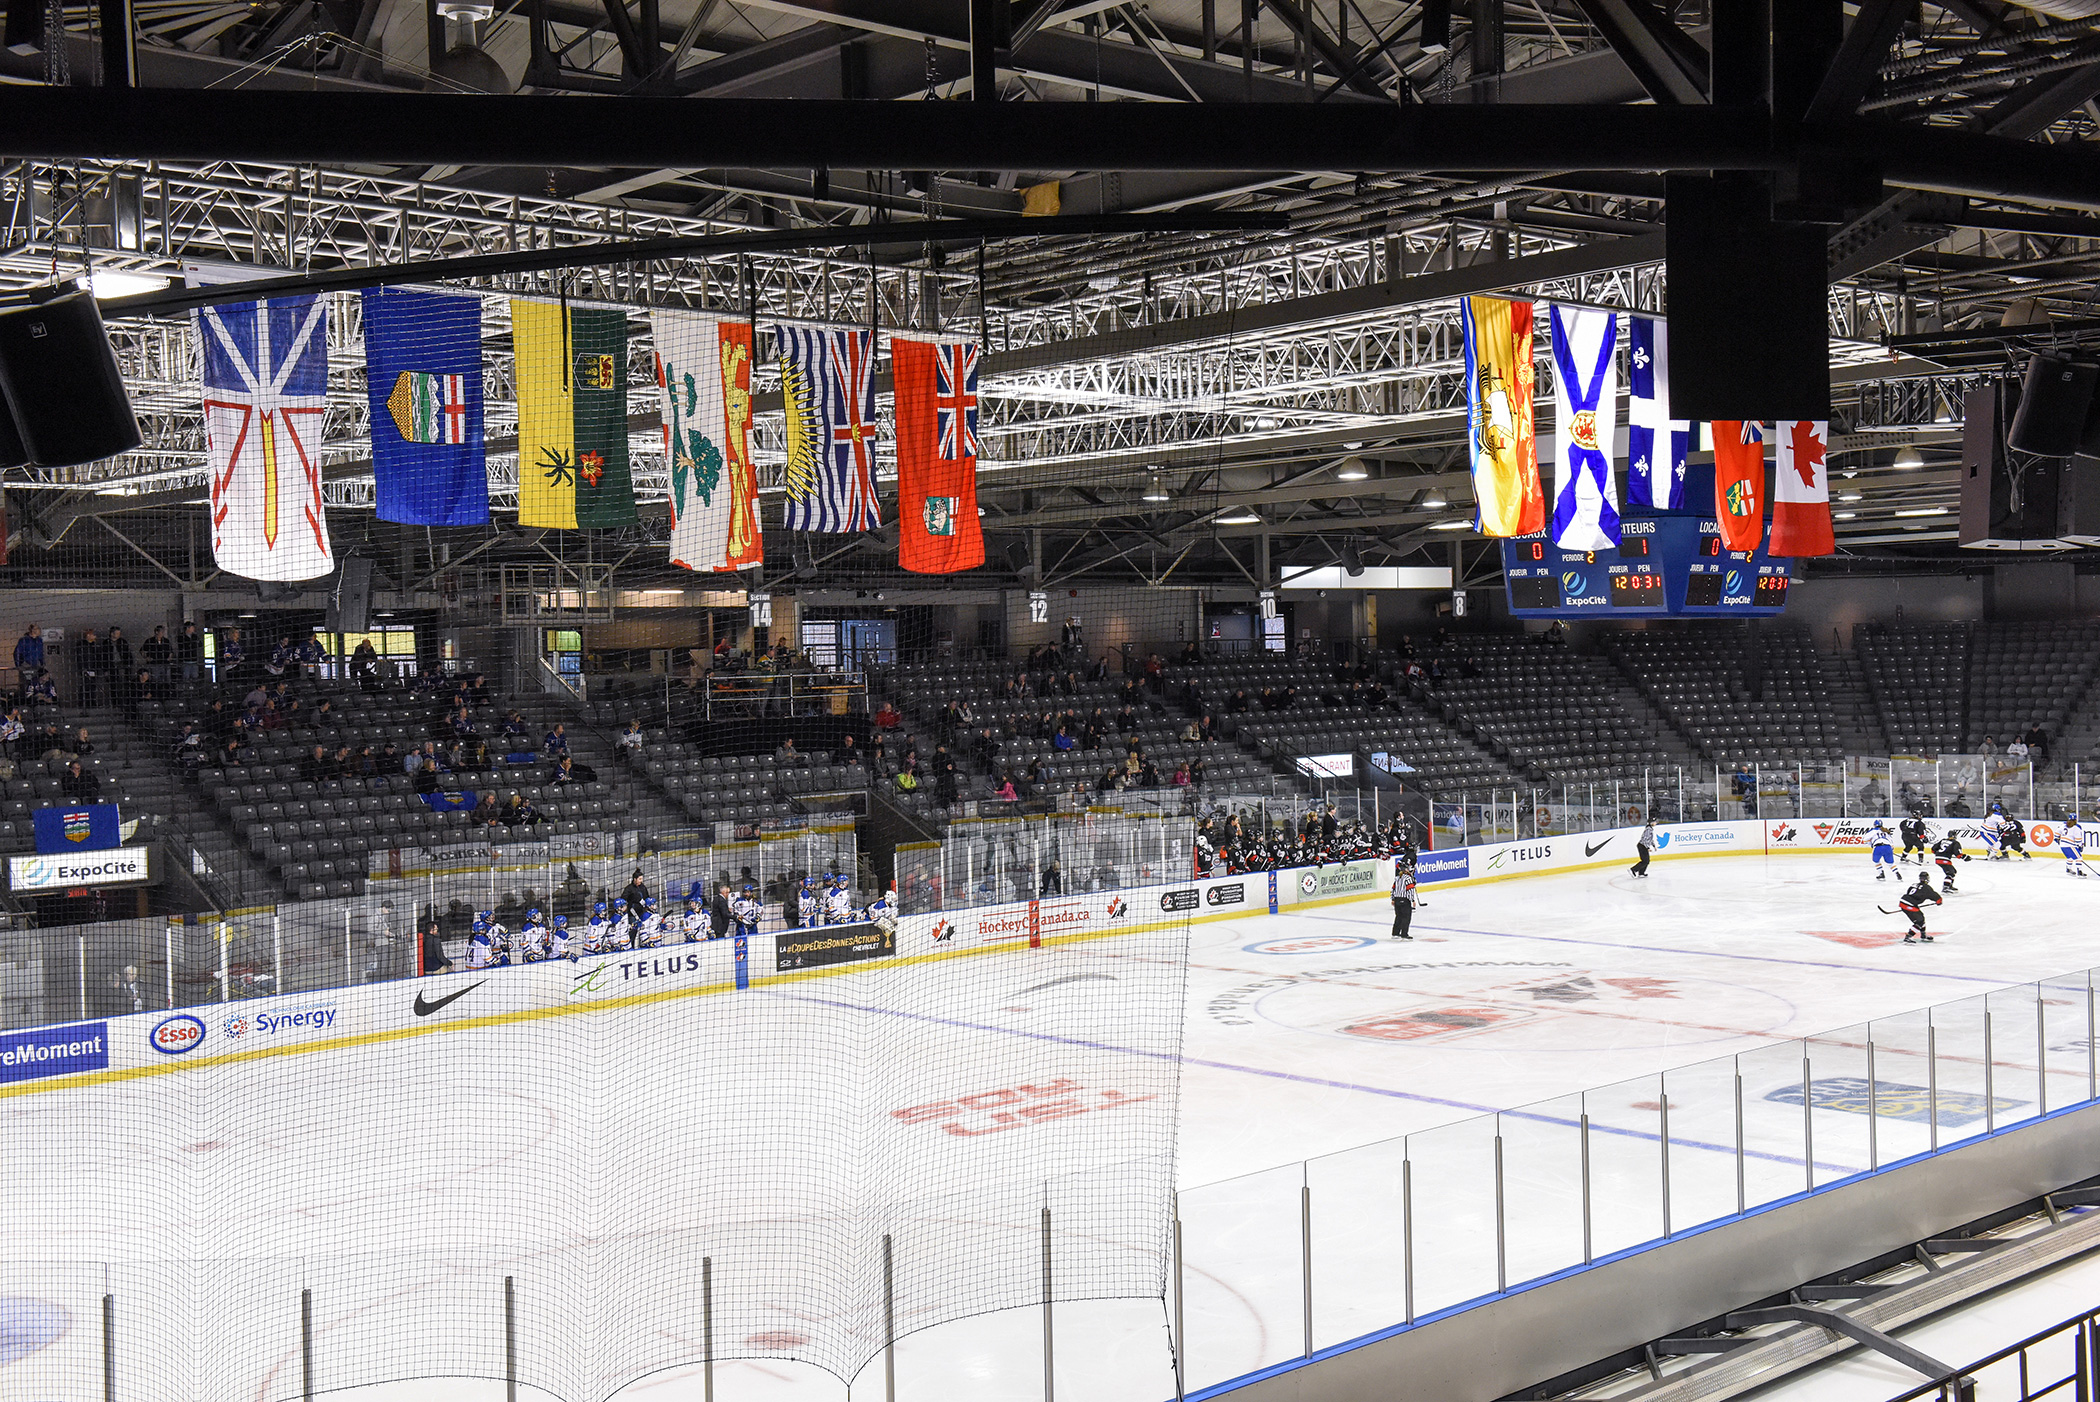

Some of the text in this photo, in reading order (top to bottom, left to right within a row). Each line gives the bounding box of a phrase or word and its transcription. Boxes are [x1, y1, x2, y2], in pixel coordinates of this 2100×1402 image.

[1621, 521, 1656, 535] ITEURS
[1532, 538, 1648, 560] 0 1
[1711, 537, 1720, 556] 0
[1260, 598, 1276, 620] 10
[1456, 596, 1464, 616] 8
[1566, 596, 1607, 607] ExpoCité
[1723, 596, 1751, 606] ExpoCité
[750, 602, 773, 627] 14
[1029, 600, 1047, 623] 12
[1299, 759, 1350, 773] ESTAURANT
[1674, 831, 1735, 843] Hockey Canada
[1511, 845, 1552, 862] TELUS
[58, 860, 137, 880] ExpoCité
[1415, 857, 1468, 874] VotreMoment
[619, 954, 699, 980] TELUS
[256, 1009, 336, 1035] Synergy
[158, 1027, 198, 1044] Esso
